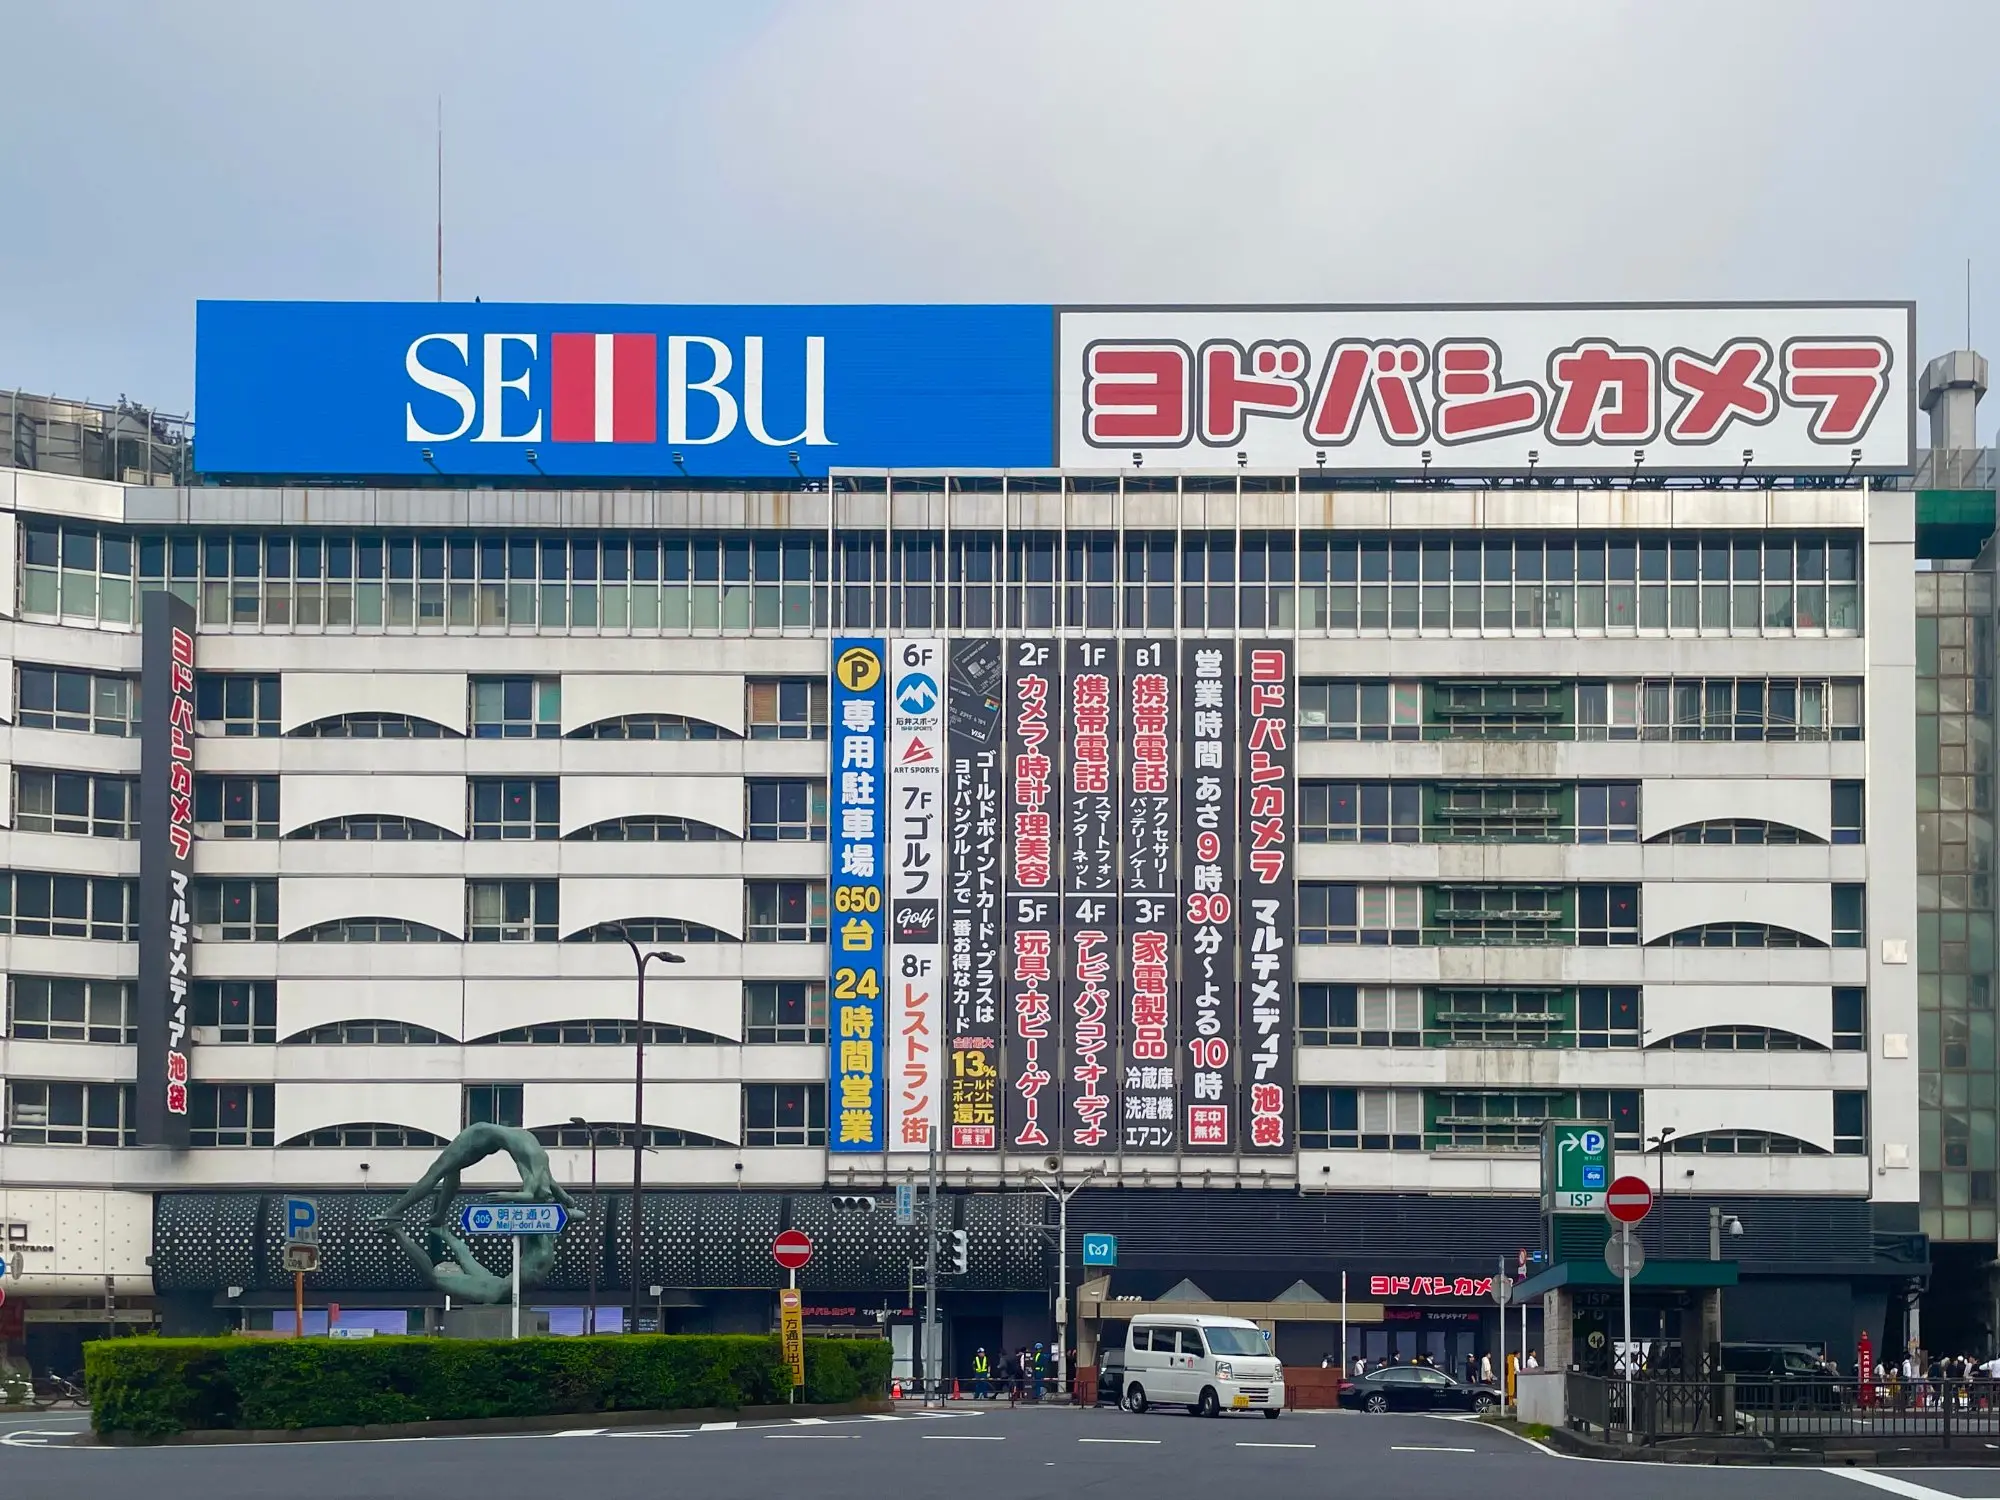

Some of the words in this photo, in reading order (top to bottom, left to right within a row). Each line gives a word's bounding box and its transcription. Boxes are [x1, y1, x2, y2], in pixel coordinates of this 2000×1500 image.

[405, 333, 838, 446] SEIBU
[1082, 335, 1893, 449] ヨドバシカメラ
[903, 643, 932, 667] 6F
[1019, 642, 1049, 666] 2F
[1079, 642, 1106, 667] 1F
[1136, 642, 1161, 667] B1
[1194, 649, 1223, 769] 営業時間
[170, 626, 193, 860] ヨドバシカメラ
[970, 728, 986, 740] VISA
[1073, 674, 1109, 793] 携帯電話
[1132, 674, 1168, 793] 携帯電話
[1248, 649, 1286, 884] ヨドバシカメラ
[902, 786, 931, 809] 7F
[902, 814, 933, 894] ゴルフ
[1072, 797, 1089, 889] インターネット
[1095, 797, 1111, 889] スマートフォン
[1153, 797, 1169, 888] アクセサリー
[897, 908, 935, 928] Golf
[1018, 899, 1047, 923] 5F
[1075, 899, 1106, 923] 4F
[1135, 899, 1165, 923] 3F
[901, 954, 931, 977] 8F
[1132, 931, 1168, 1059] 家電製品
[901, 983, 929, 1144] レストラン街
[952, 1051, 997, 1077] 13%
[953, 1080, 994, 1090] ゴールド
[1125, 1067, 1173, 1089] 冷蔵庫
[953, 1091, 994, 1102] ポイント
[1125, 1096, 1173, 1120] 洗濯機
[953, 1103, 994, 1124] 還元
[1126, 1127, 1173, 1147] エアコン
[1571, 1194, 1592, 1206] ISP
[289, 1200, 314, 1237] P
[475, 1215, 490, 1224] 305
[496, 1221, 533, 1231] Meiji-dori
[498, 1209, 551, 1220] 明治通り
[10, 1244, 54, 1252] Entrance
[1371, 1276, 1513, 1296] ヨドバシカメ
